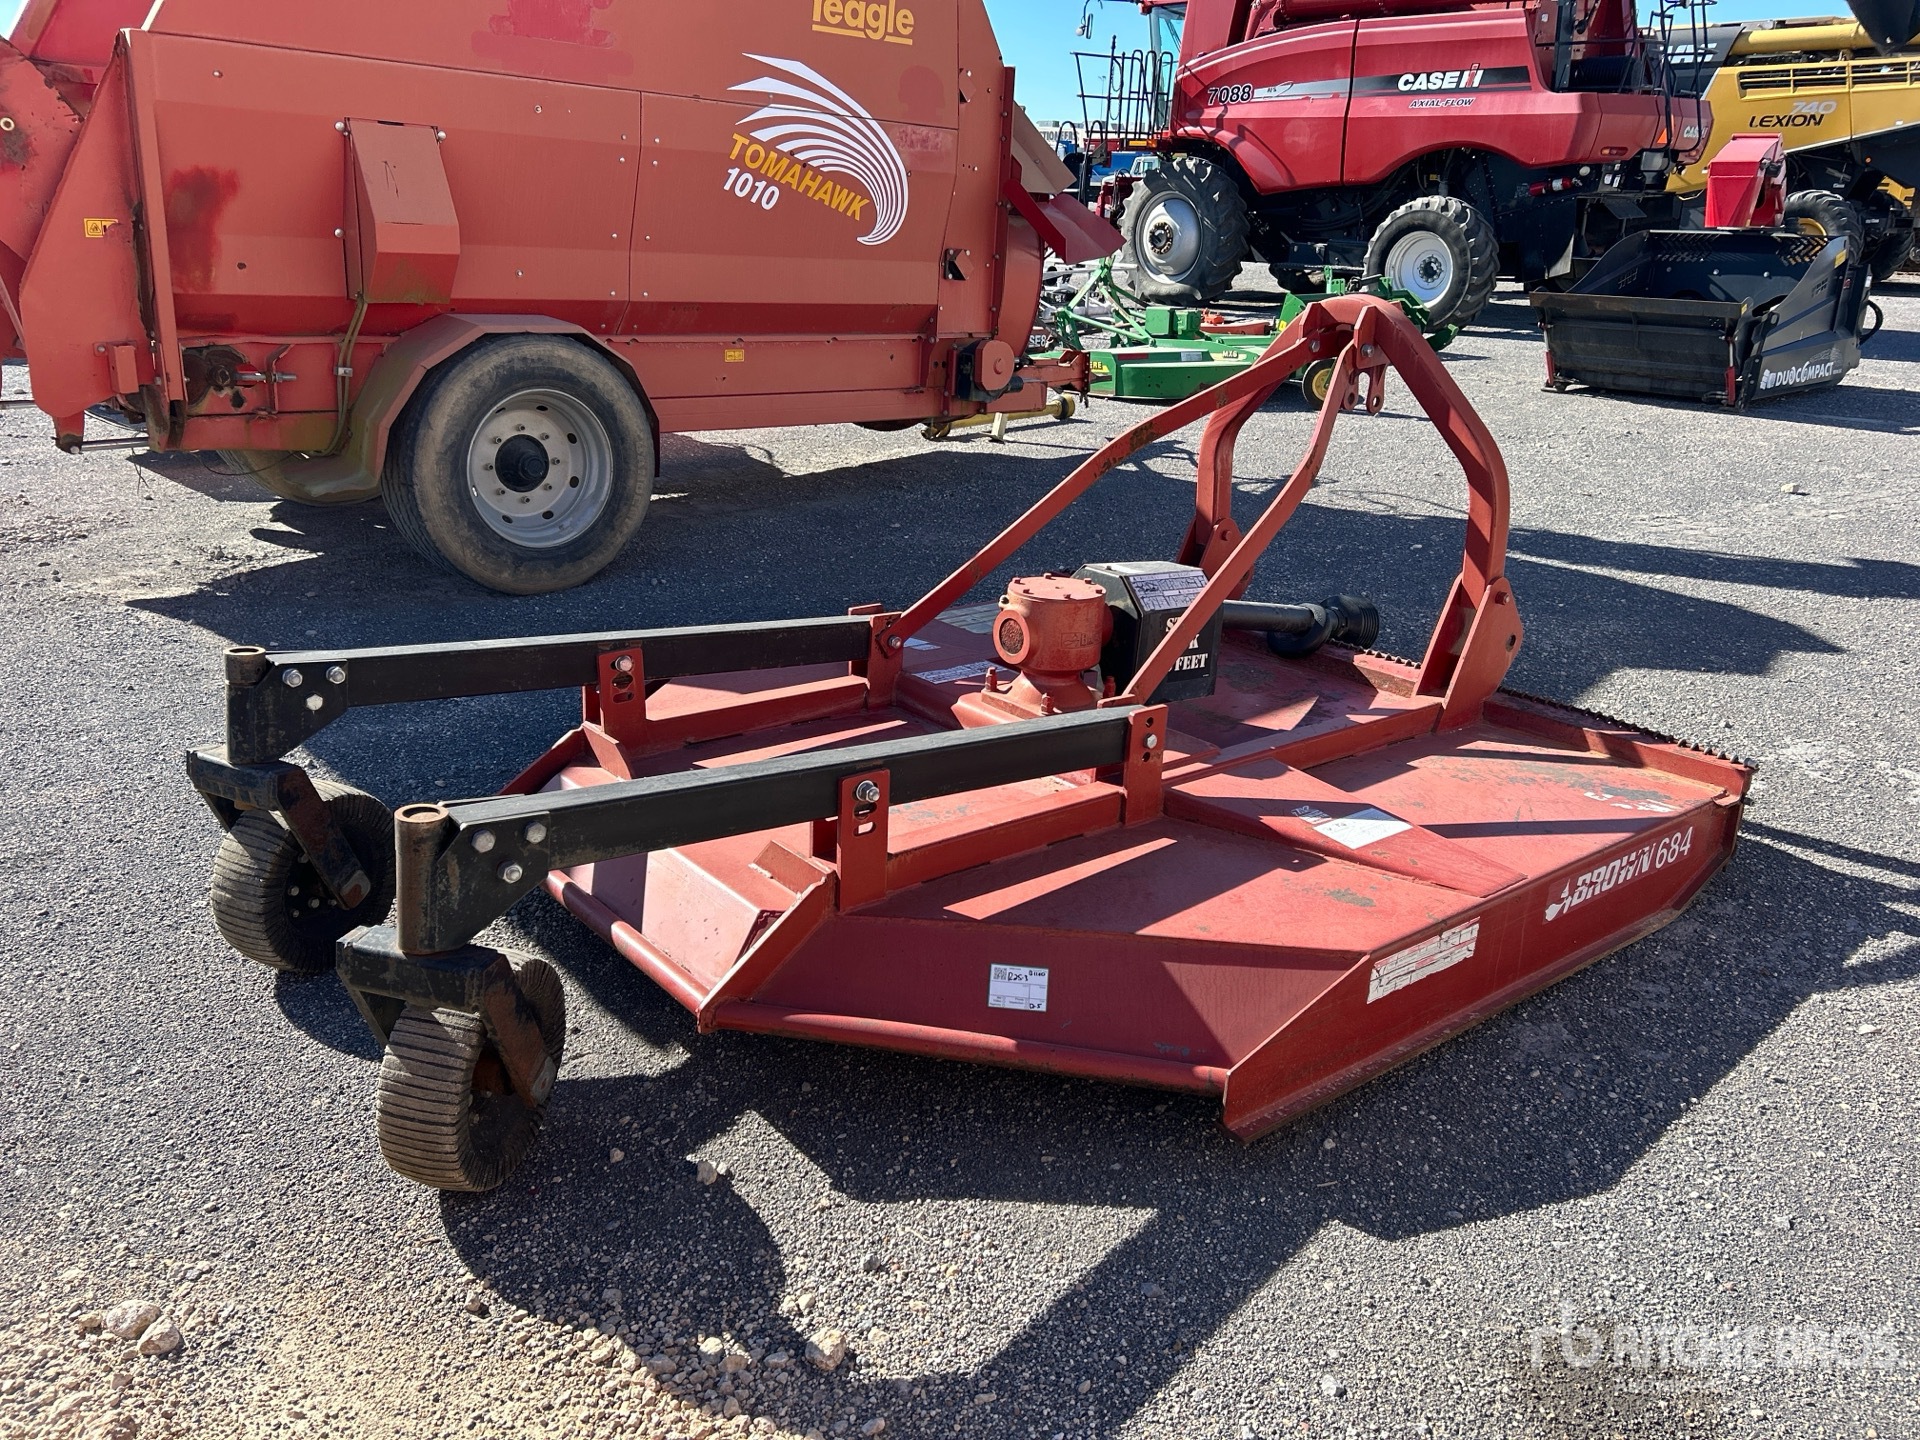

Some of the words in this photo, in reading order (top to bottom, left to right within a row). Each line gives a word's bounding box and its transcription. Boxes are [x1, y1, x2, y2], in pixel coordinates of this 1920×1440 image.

[1397, 71, 1460, 91] CASE
[1207, 83, 1252, 106] 7088
[1408, 96, 1476, 109] AXIAL-FLOW
[1790, 100, 1837, 115] 740
[1749, 113, 1825, 128] LEXION
[729, 132, 870, 221] TOMAHAWK
[723, 167, 780, 210] 1010
[1775, 361, 1834, 387] DUOCOMPACT
[1174, 653, 1209, 672] FEET
[1571, 843, 1657, 907] BROWN
[1655, 826, 1693, 868] 684
